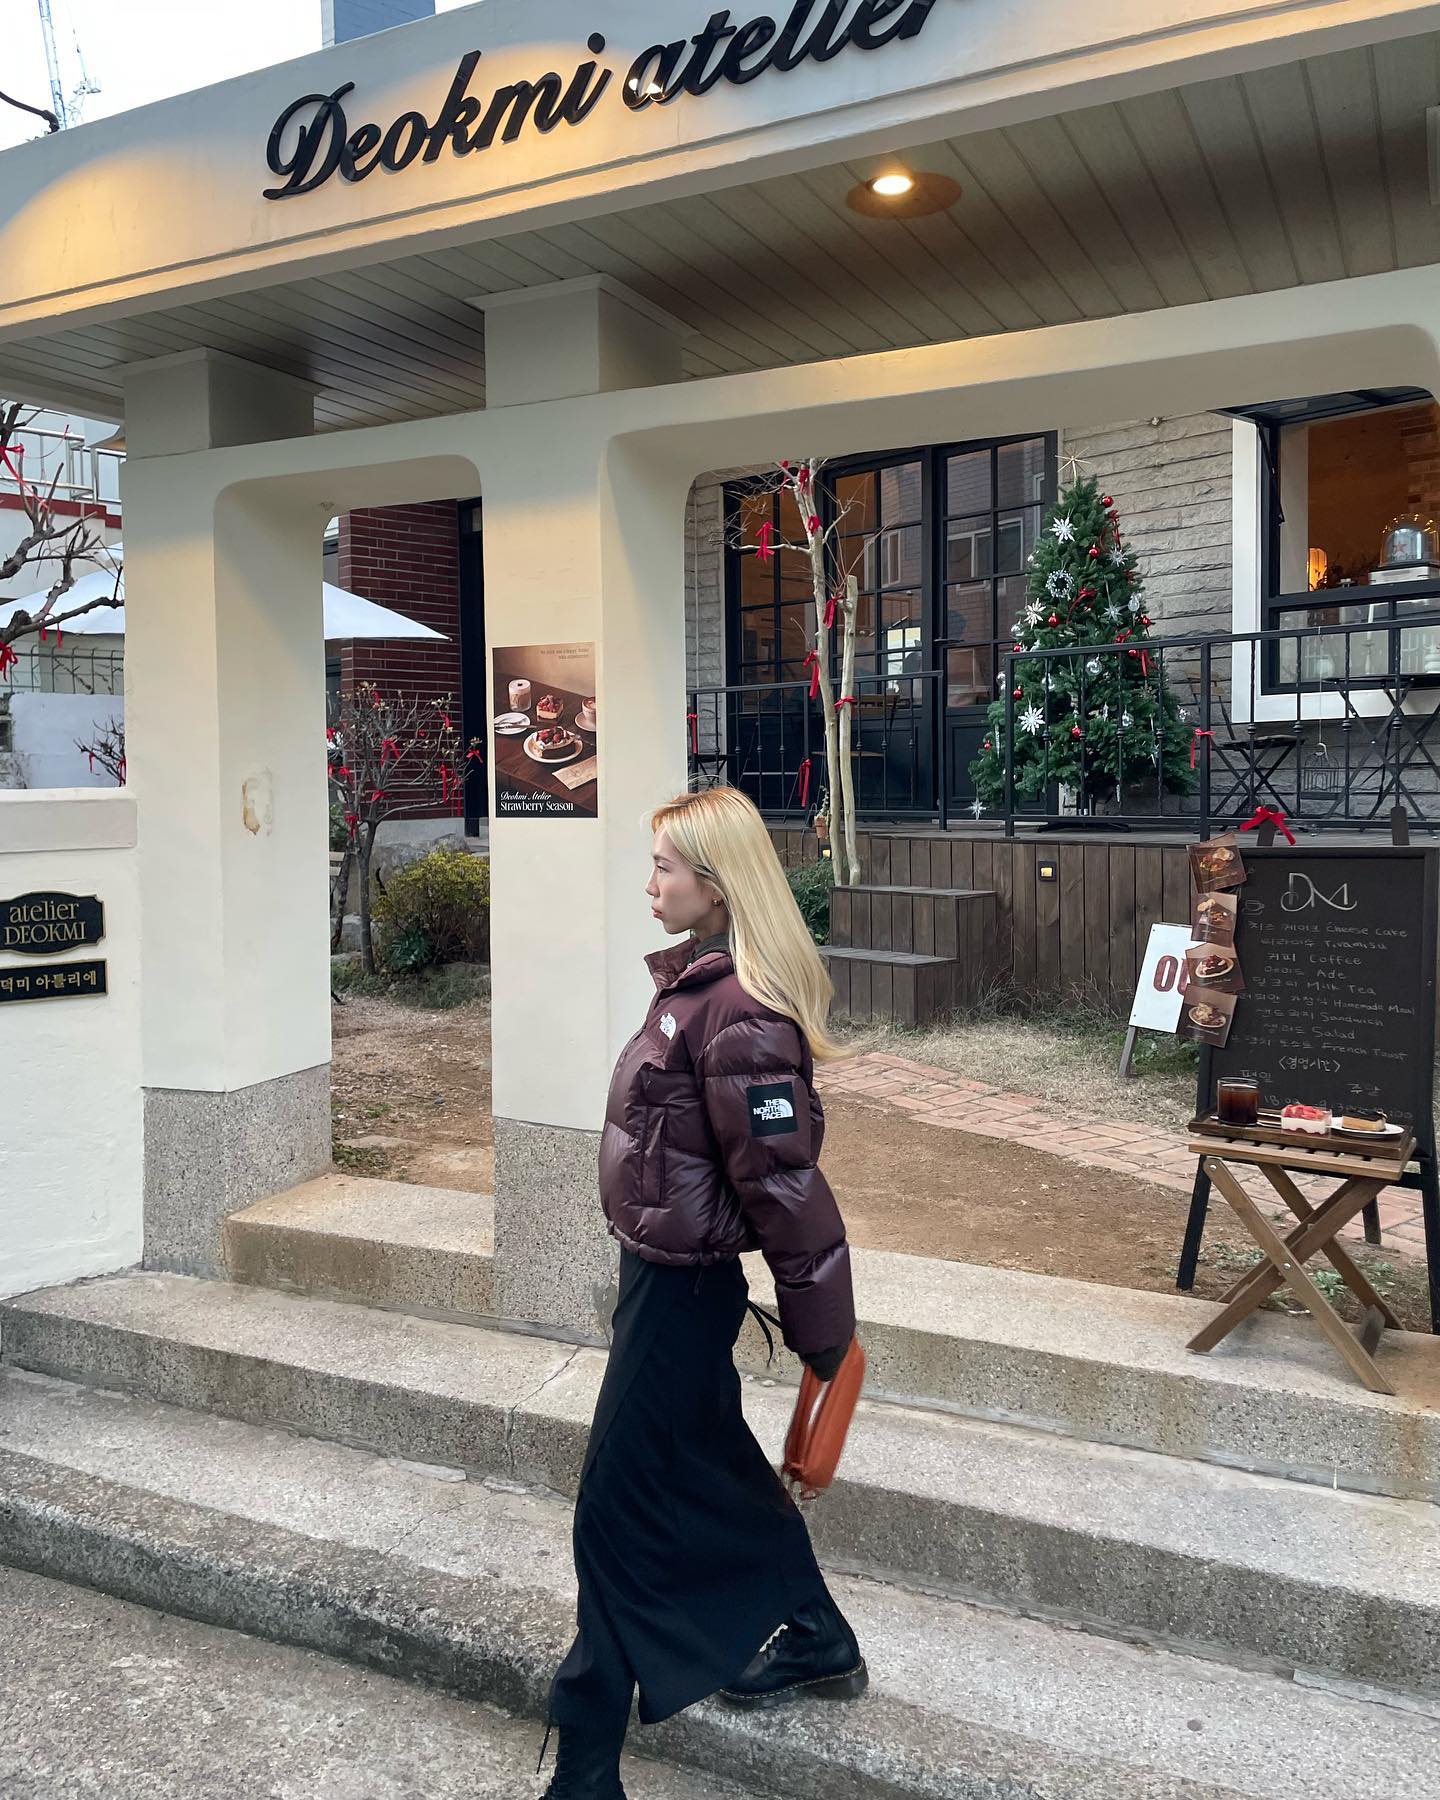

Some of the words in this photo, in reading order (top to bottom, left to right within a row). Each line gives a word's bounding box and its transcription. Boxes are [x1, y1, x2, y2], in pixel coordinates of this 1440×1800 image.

[263, 32, 612, 200] Deokmi
[501, 790, 528, 800] Deokmi
[528, 790, 552, 800] Atelier
[501, 801, 544, 812] Strawberry
[545, 801, 574, 811] Season
[9, 901, 79, 923] atelier
[4, 921, 87, 945] DEOKMI
[1267, 953, 1297, 963] 커피
[1316, 969, 1348, 980] Ade
[1, 977, 30, 993] 덕미
[1348, 984, 1377, 996] Tea
[1319, 1011, 1384, 1027] Sandwich
[1311, 1026, 1356, 1040] Salad
[753, 1105, 779, 1115] NORTH
[762, 1112, 782, 1121] FACE
